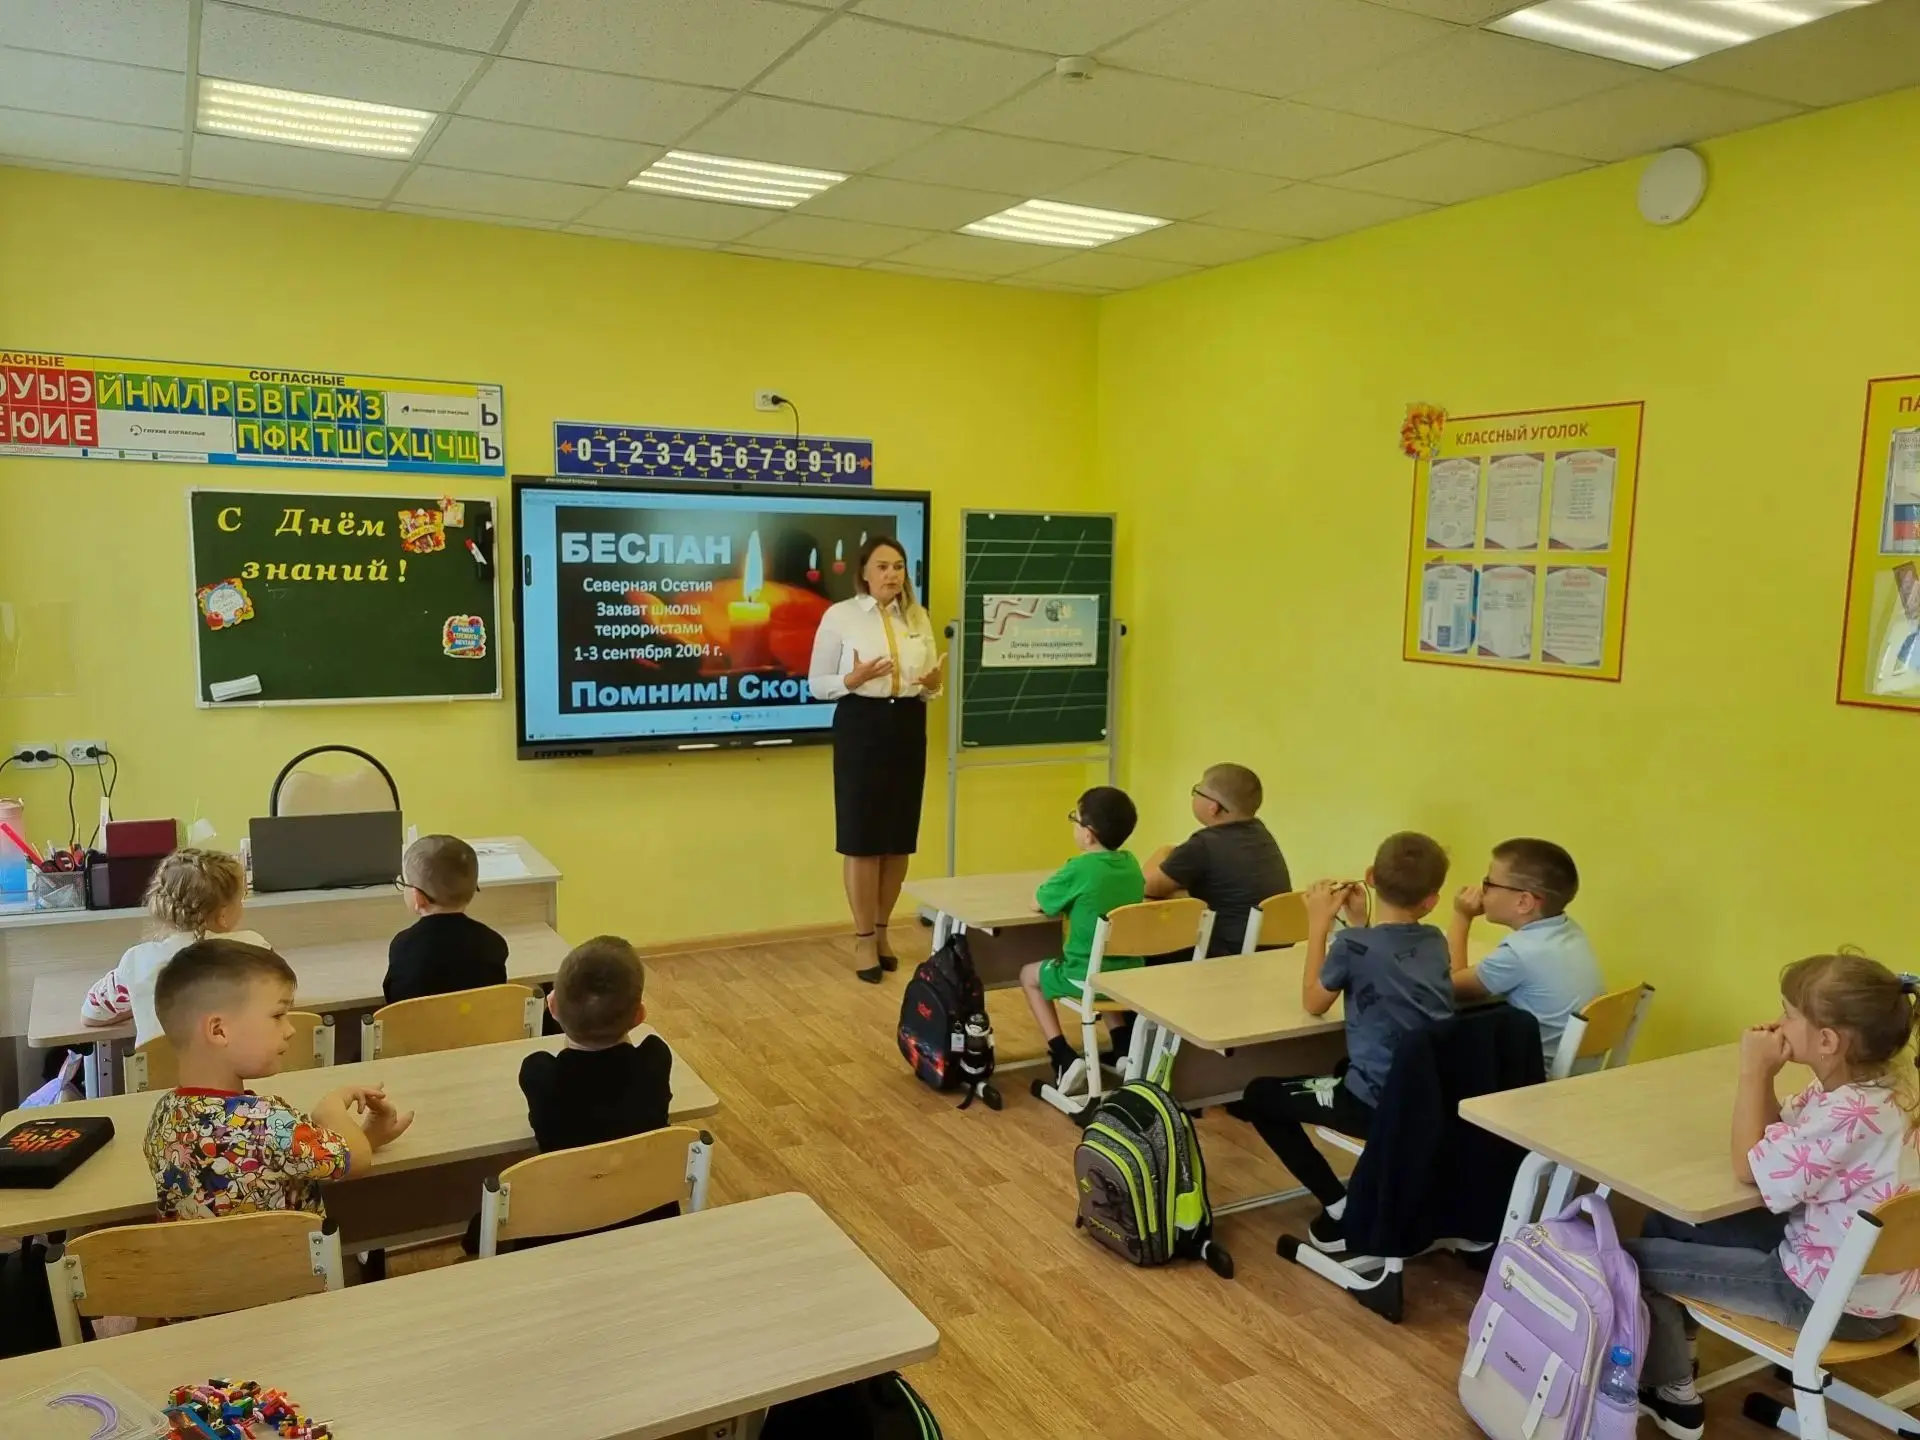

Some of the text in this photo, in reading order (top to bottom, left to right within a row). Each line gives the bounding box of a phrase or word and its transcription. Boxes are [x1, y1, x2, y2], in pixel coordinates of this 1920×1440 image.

[249, 370, 346, 386] СОГЛАСНЫЕ
[481, 403, 498, 427] Ь
[1455, 422, 1589, 446] КЛАССНЫЙ УГОЛОК
[481, 437, 501, 460] Ъ
[577, 438, 857, 474] 0 1 2 3 4 5 6 7 8 9 10
[217, 507, 242, 532] С
[274, 508, 386, 537] Днём
[561, 532, 732, 565] БЕСЛАН
[583, 577, 713, 594] Северная Осетия
[596, 602, 701, 617] Захват школы
[595, 622, 703, 639] террористами
[574, 643, 723, 661] 1-3 сентября 2004 г.
[571, 675, 728, 707] Помним!
